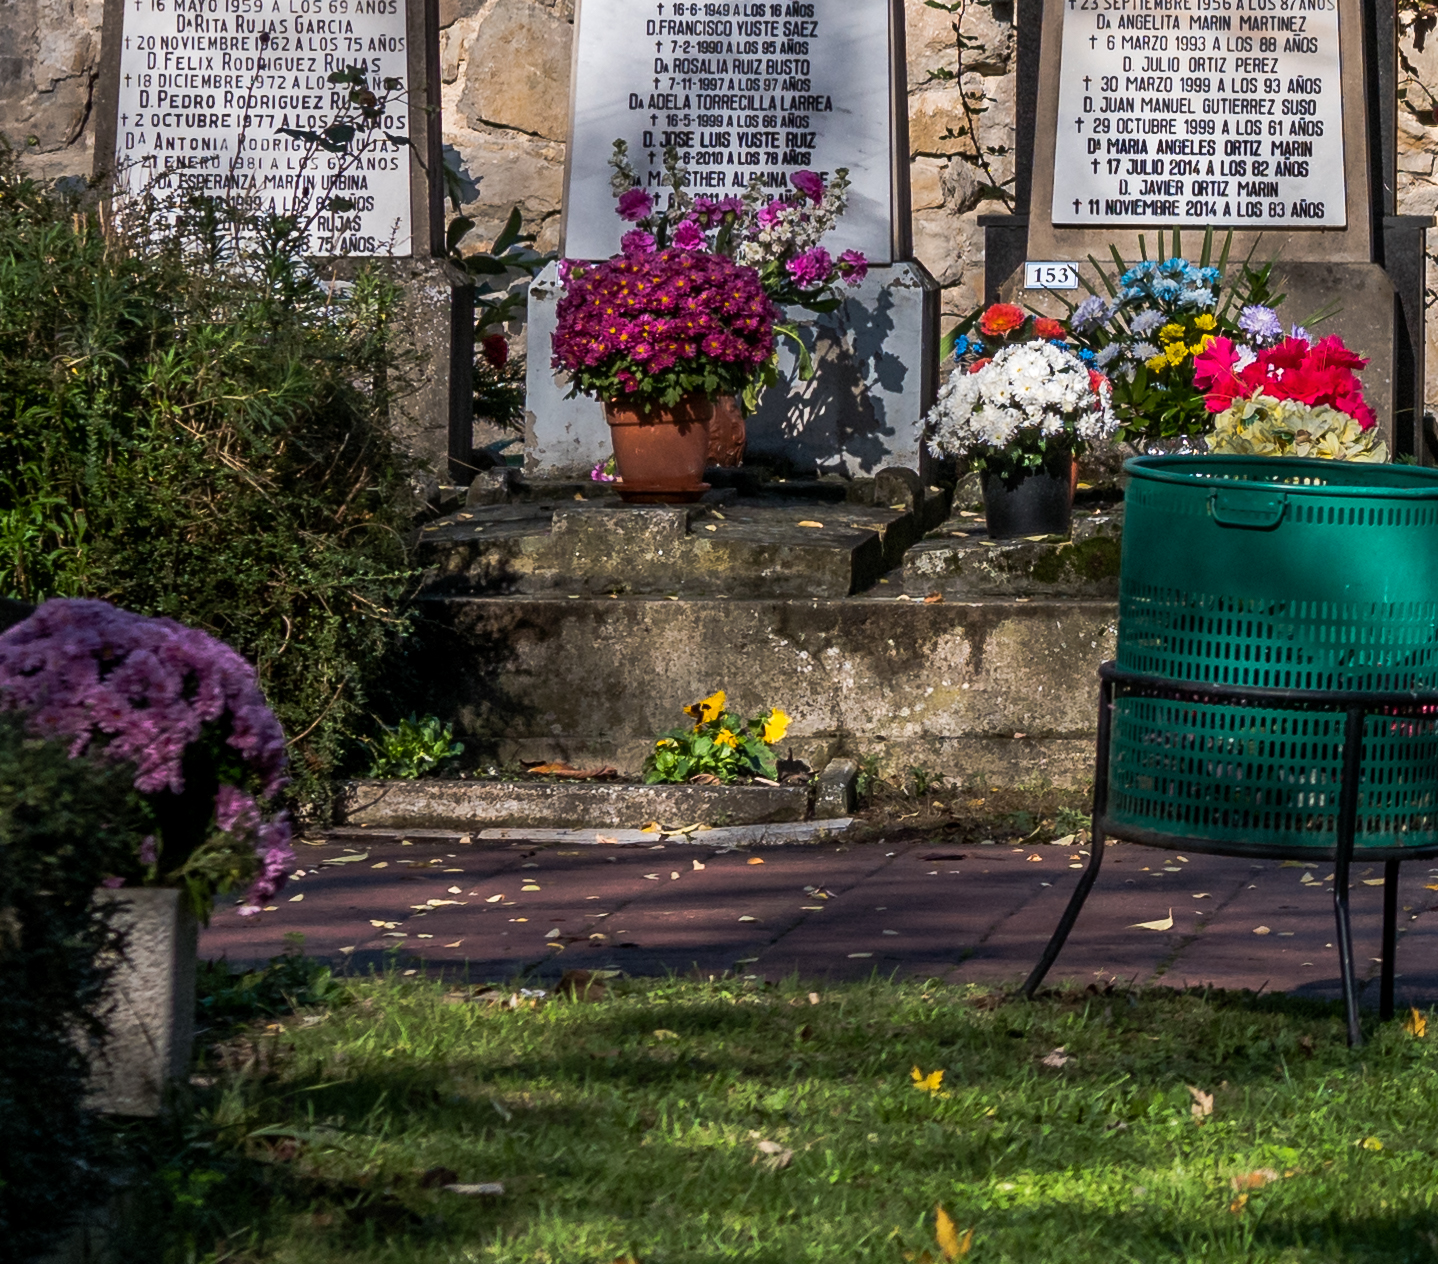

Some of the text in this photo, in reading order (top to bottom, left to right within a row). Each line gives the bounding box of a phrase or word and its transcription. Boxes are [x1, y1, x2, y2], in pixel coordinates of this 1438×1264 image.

[226, 0, 263, 13] 1959
[290, 0, 322, 14] LOS
[329, 0, 348, 14] 69
[744, 3, 766, 17] LOS
[770, 4, 782, 18] 16
[785, 1, 814, 18] AÑOS
[737, 20, 779, 37] YUSTE
[783, 21, 818, 38] SAEZ
[673, 58, 729, 75] ROSALIA
[733, 58, 763, 75] RUIZ
[766, 59, 810, 76] BUSTO
[1142, 56, 1180, 73] JULIO
[1189, 57, 1227, 73] ORTIZ
[1236, 57, 1278, 74] PEREZ
[1140, 179, 1184, 196] JAVIER
[1192, 180, 1229, 197] ORTIZ
[1238, 181, 1278, 197] MARIN
[1088, 199, 1100, 216] 11
[1106, 199, 1180, 216] NOVIEMBRE
[1186, 200, 1217, 217] 2014
[1237, 201, 1263, 218] LOS
[1269, 202, 1285, 218] 83
[1291, 199, 1324, 219] AÑOS
[1034, 268, 1069, 283] 153
